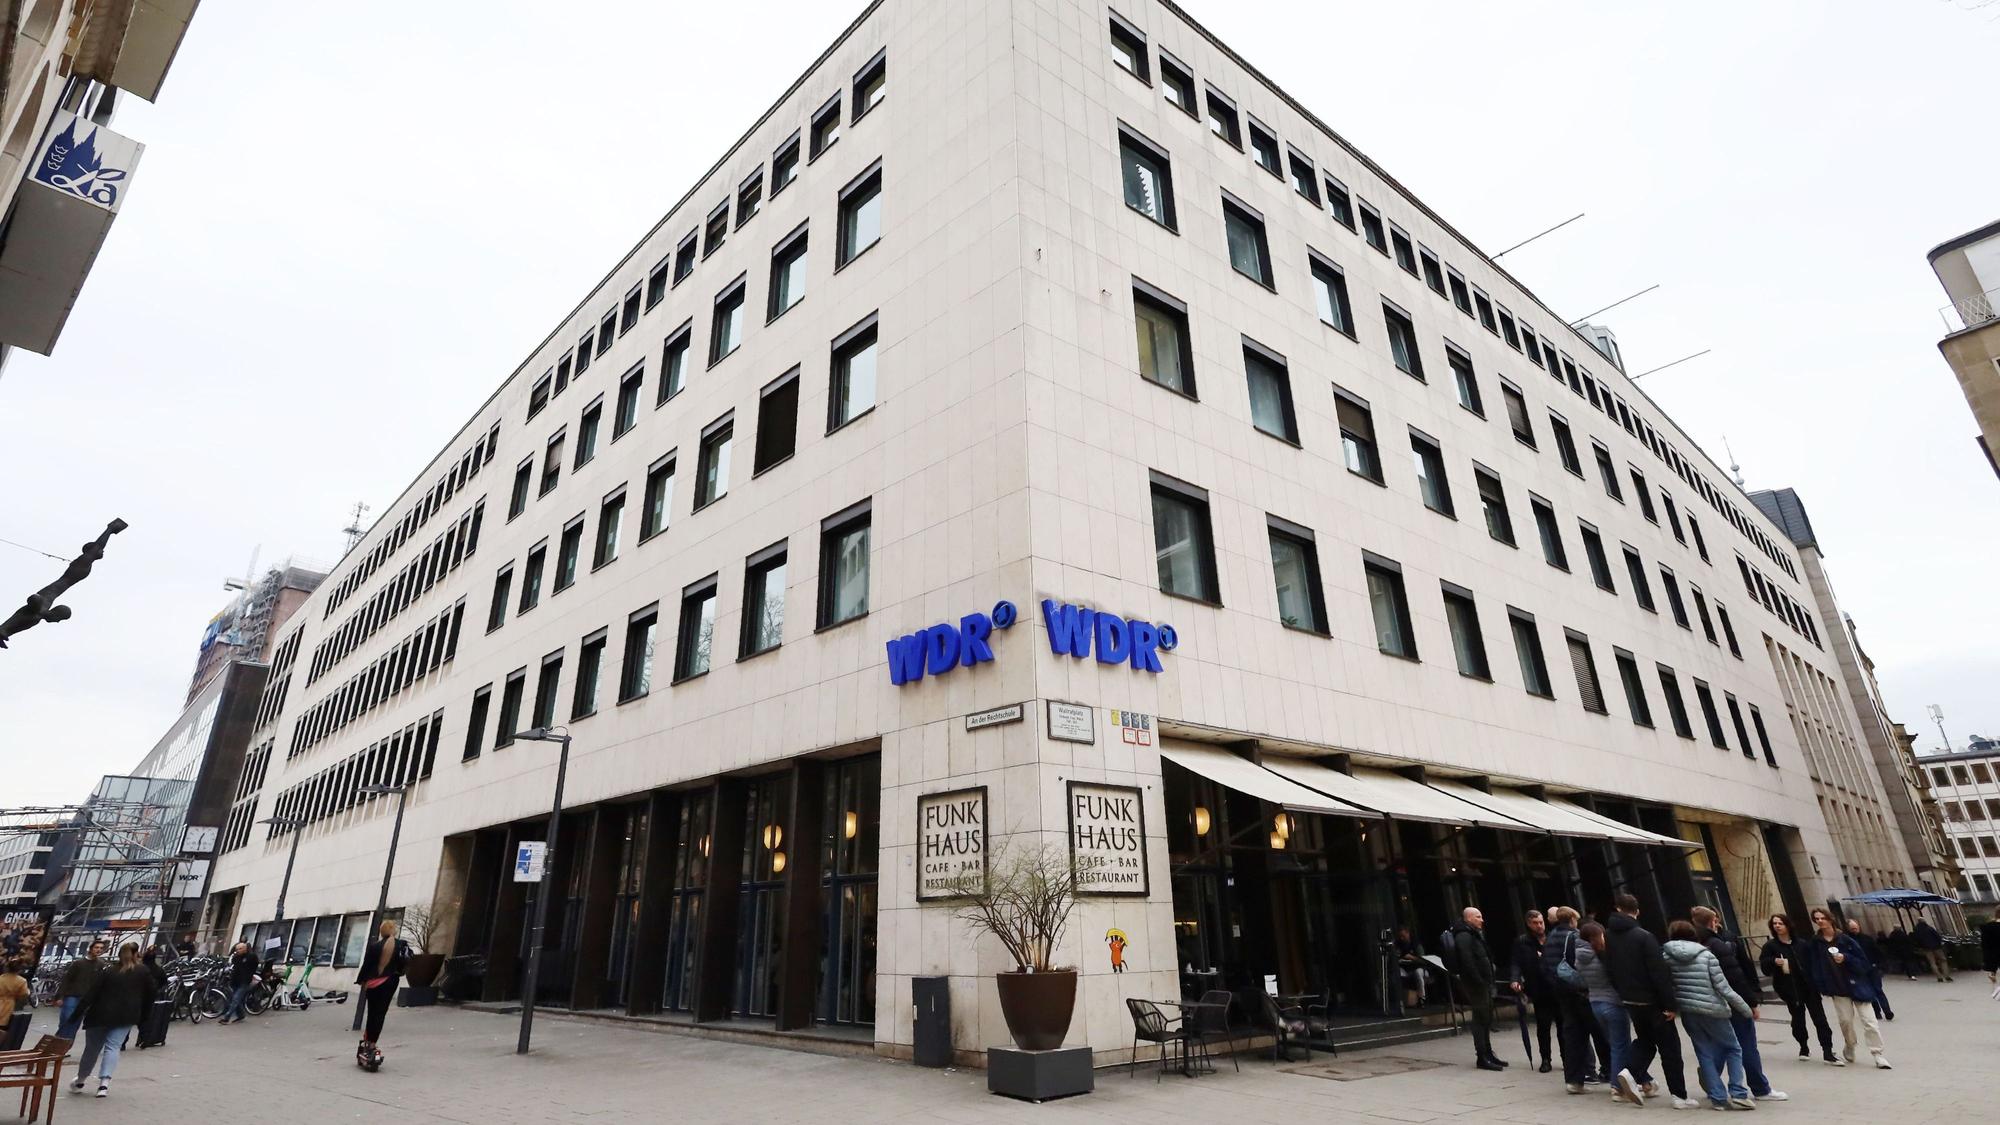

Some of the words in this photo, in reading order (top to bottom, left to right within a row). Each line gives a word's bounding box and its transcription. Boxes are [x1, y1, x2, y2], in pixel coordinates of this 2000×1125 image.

[1042, 599, 1163, 673] WDR
[886, 612, 994, 686] WDR
[979, 715, 987, 723] der
[987, 709, 1016, 722] Rechtschule
[926, 800, 980, 829] FUNK
[1076, 795, 1135, 823] FUNK
[926, 830, 981, 857] HAUS
[1077, 825, 1137, 851] HAUS
[926, 862, 949, 873] CAFE
[961, 860, 980, 871] BAR
[1079, 856, 1106, 867] CAFE
[1119, 857, 1138, 868] BAR
[926, 876, 980, 888] RESTAURANT
[1080, 872, 1139, 883] RESTAURANT
[4, 912, 40, 924] GNTM
